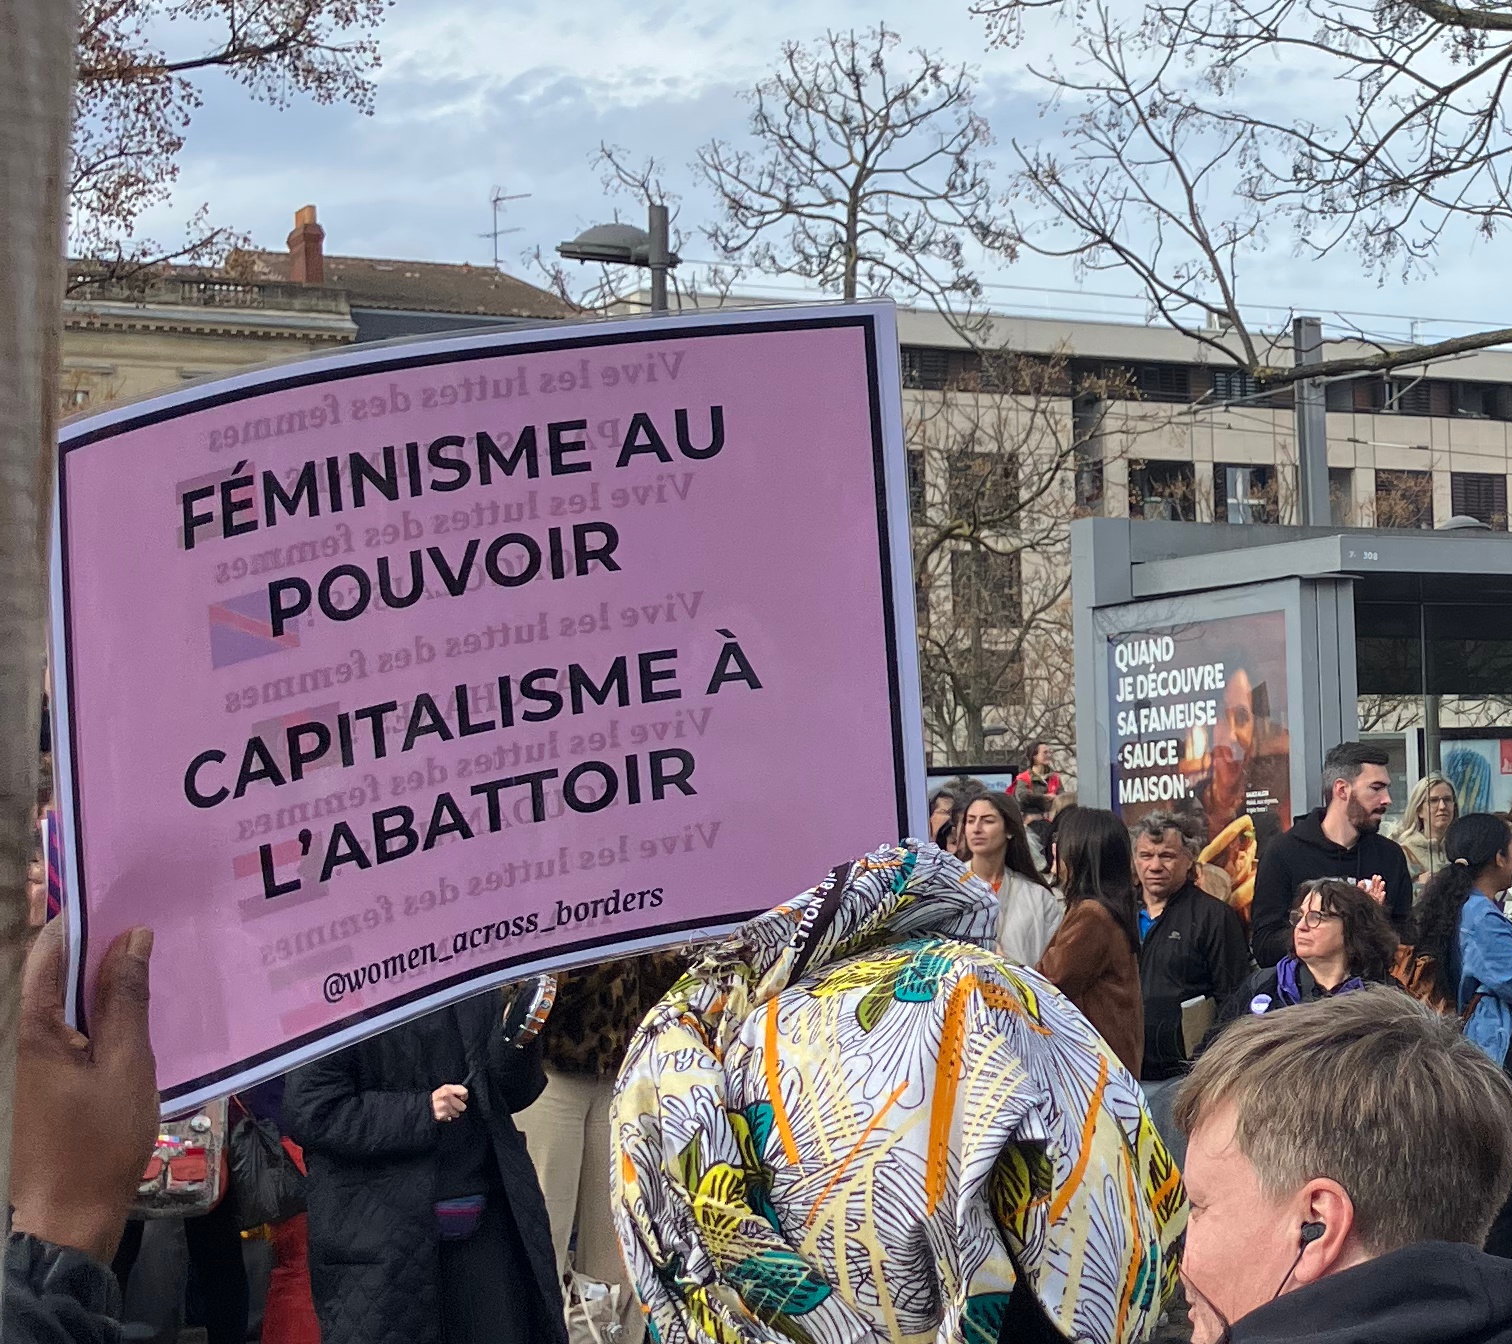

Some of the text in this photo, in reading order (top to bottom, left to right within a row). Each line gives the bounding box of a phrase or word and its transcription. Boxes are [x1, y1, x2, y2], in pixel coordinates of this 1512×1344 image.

[182, 405, 726, 550] FÉMINISME AU
[267, 520, 622, 637] POUVOIR
[1115, 636, 1175, 673] QUAND
[1116, 663, 1226, 703] JE DÉCOUVRE
[183, 629, 764, 808] CAPITALISME À
[1117, 699, 1218, 736] SA FAMEUSE
[323, 885, 664, 1004] @women_across_borders
